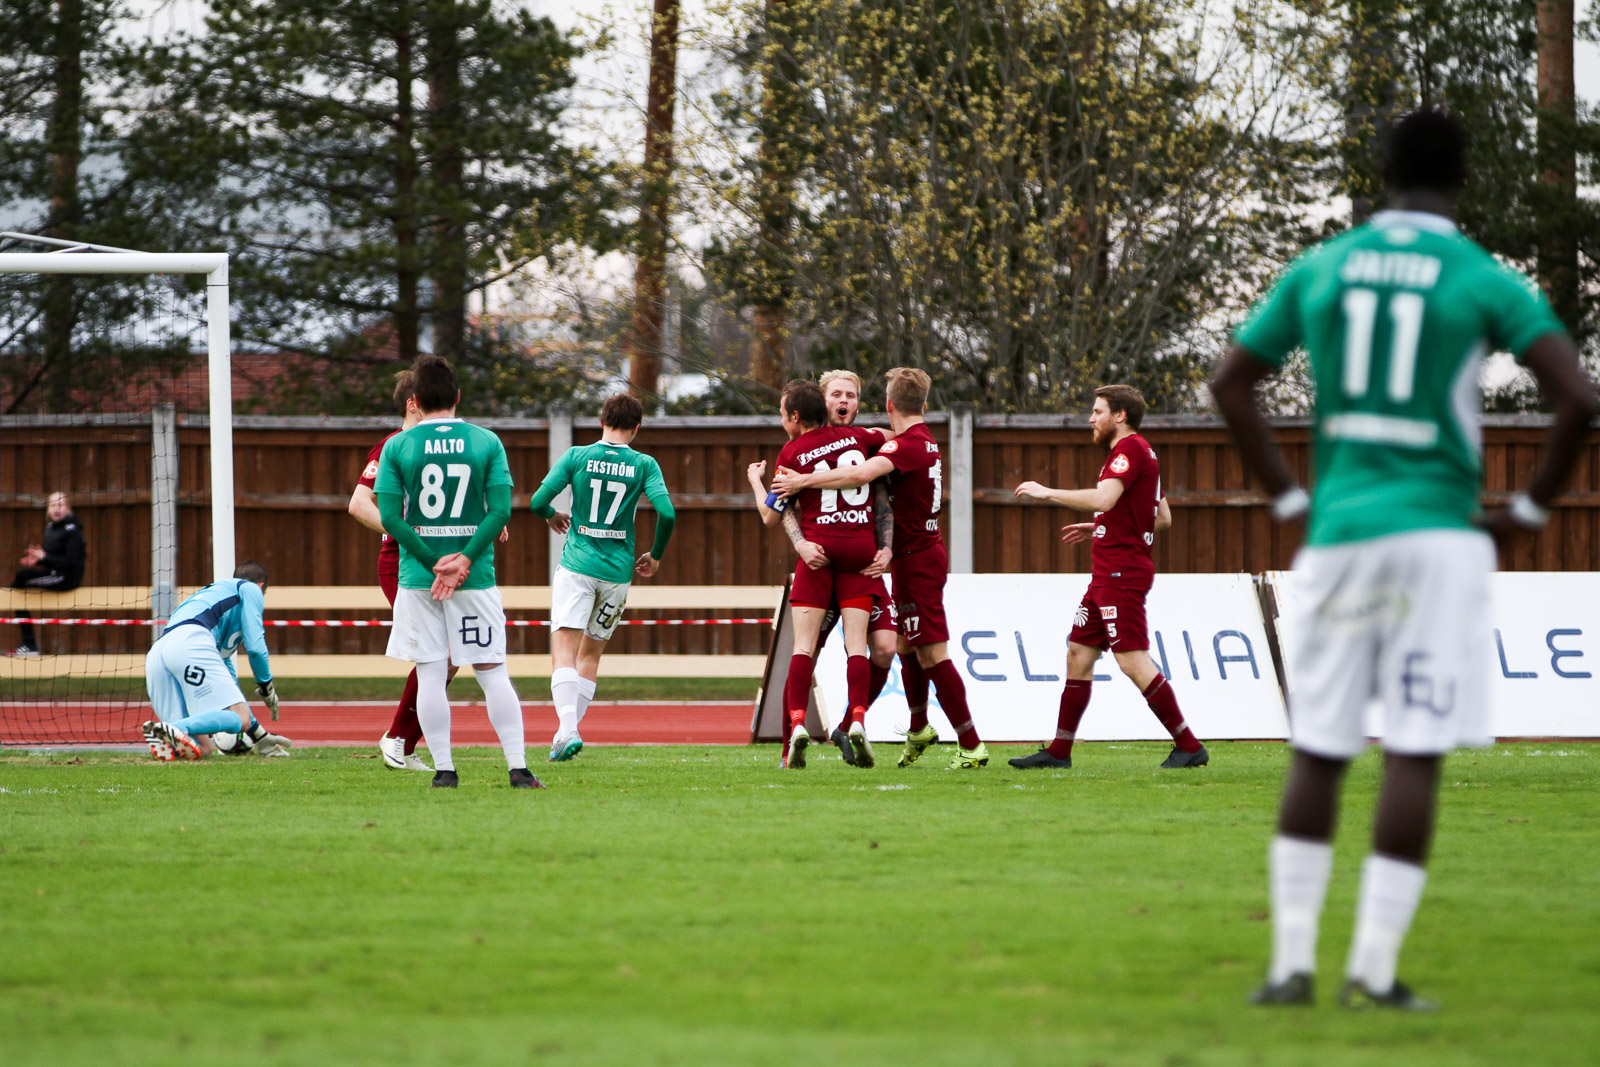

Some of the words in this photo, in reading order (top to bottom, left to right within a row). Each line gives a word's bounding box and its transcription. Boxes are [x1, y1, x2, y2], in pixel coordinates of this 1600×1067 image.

[1342, 286, 1426, 403] 11
[424, 439, 465, 454] AALTO
[807, 436, 858, 460] KESKIMAA
[586, 459, 636, 478] EKSTRÖM
[418, 463, 472, 519] 87
[589, 478, 627, 525] 17
[904, 616, 920, 632] 17
[1107, 622, 1118, 638] 5
[961, 630, 1260, 681] ELIA
